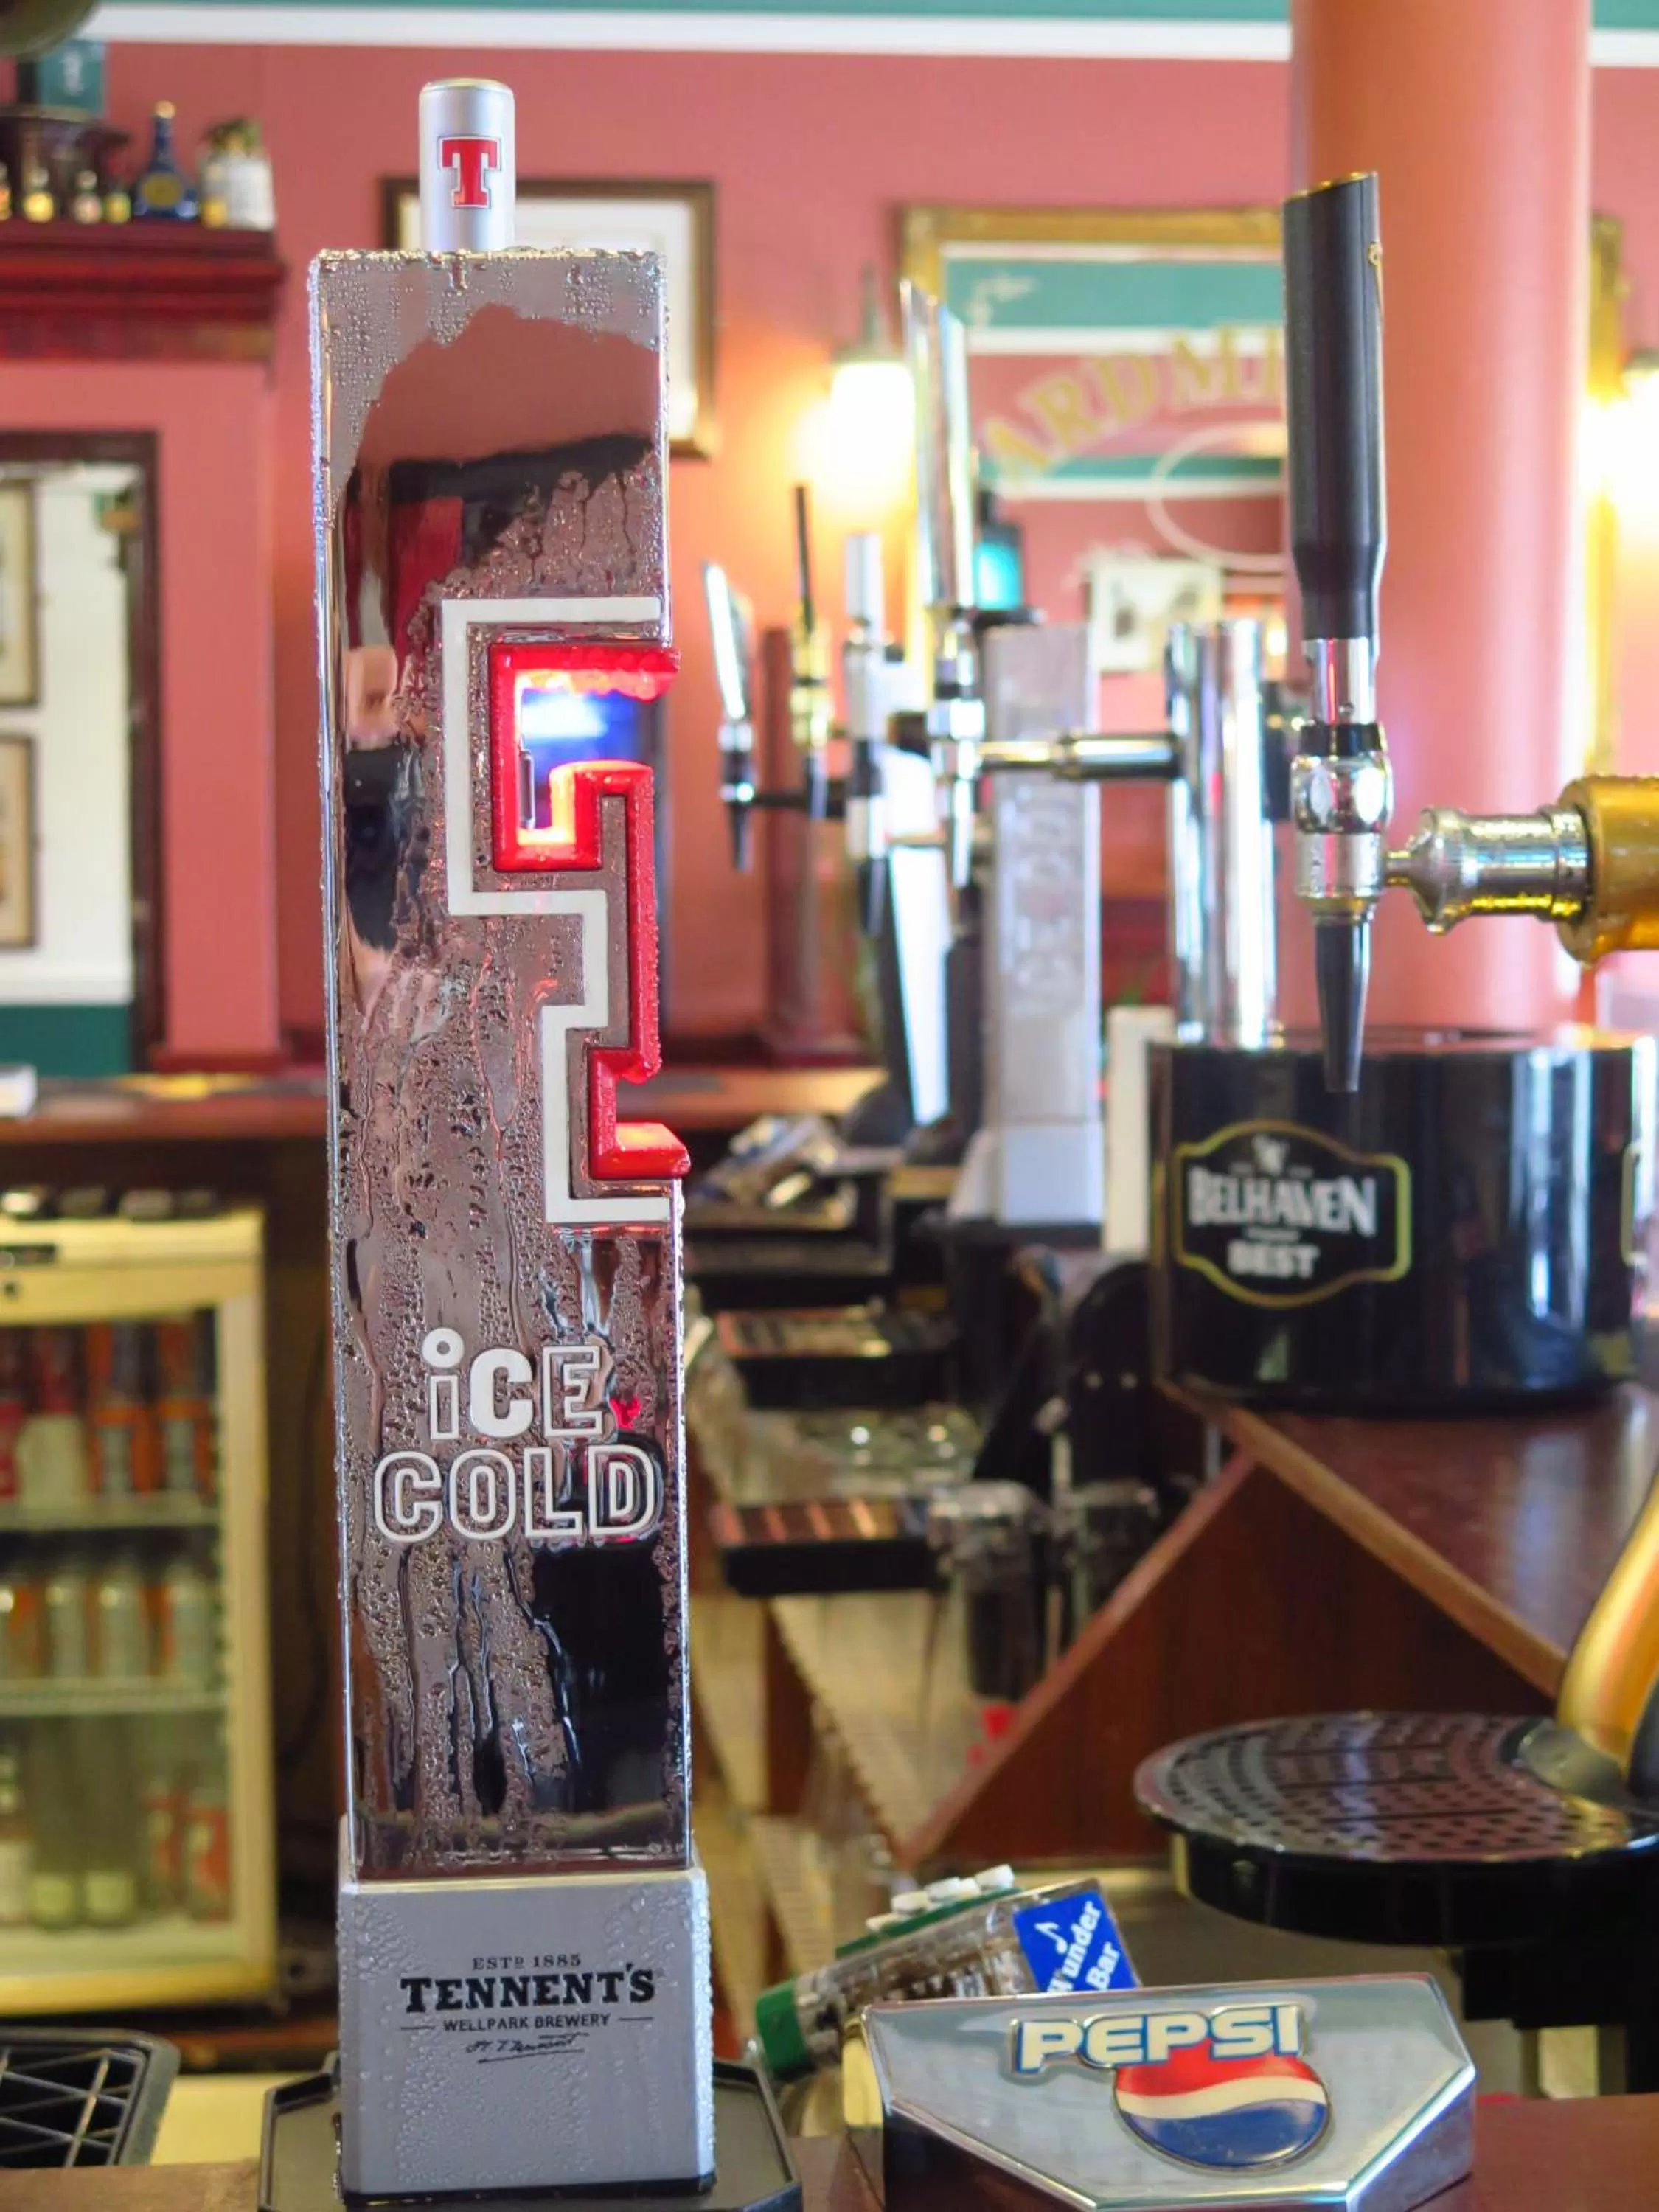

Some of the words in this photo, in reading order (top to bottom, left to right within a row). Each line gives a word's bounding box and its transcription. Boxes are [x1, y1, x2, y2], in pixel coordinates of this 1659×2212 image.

[437, 136, 501, 209] T
[1188, 1166, 1377, 1238] BELHAVEN
[373, 1444, 655, 1543] COLD
[400, 1961, 655, 2014] TENNENT'S
[534, 1954, 582, 1969] 1885
[1085, 1941, 1121, 1991] Bar
[443, 2016, 529, 2032] WELLPARK
[534, 2013, 611, 2028] BREWERY
[1014, 2003, 1301, 2075] PEPSI
